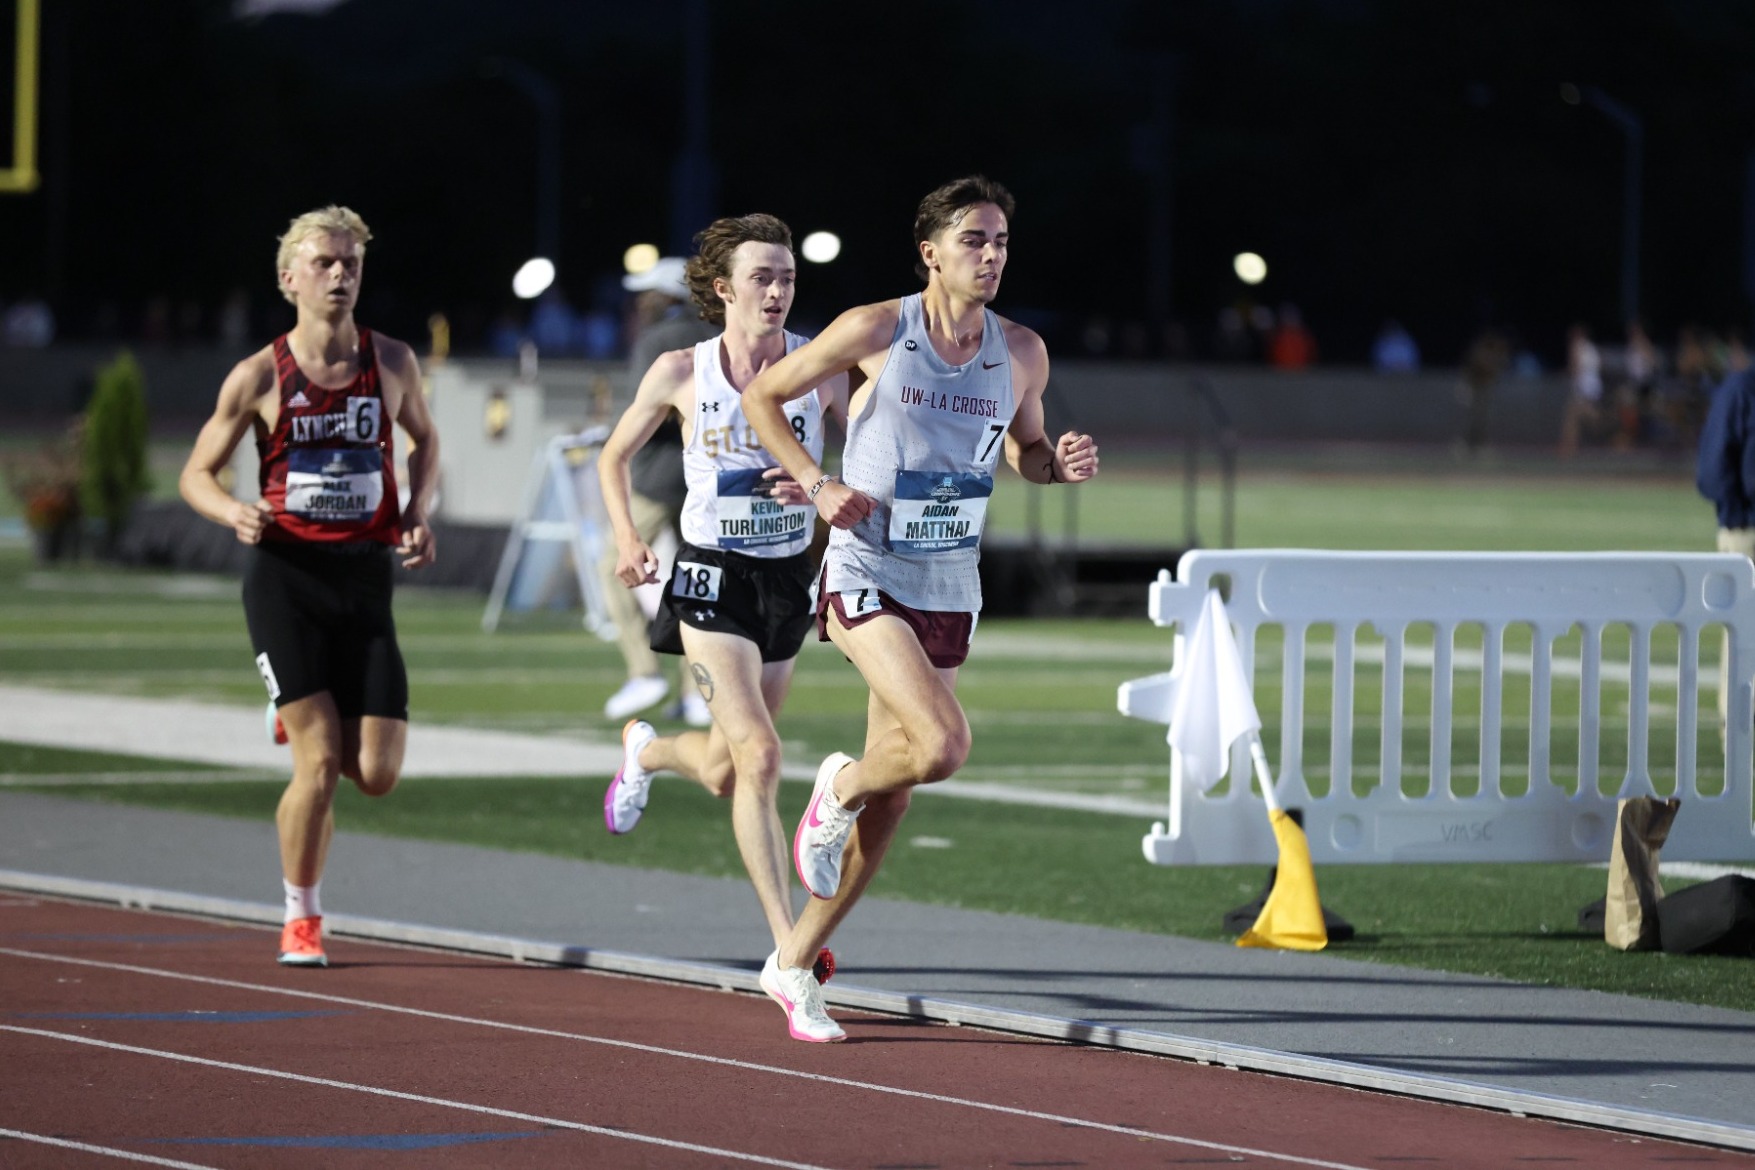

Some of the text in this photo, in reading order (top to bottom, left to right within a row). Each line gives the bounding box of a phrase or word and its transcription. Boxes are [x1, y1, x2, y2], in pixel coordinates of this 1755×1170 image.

[901, 385, 998, 418] UW-LA CROSSE
[356, 402, 373, 440] 6
[702, 425, 740, 459] ST.
[980, 425, 1005, 463] 7
[305, 494, 367, 510] JORDAN
[751, 501, 784, 515] KEVIN
[922, 505, 959, 517] AIDAN
[720, 511, 806, 536] TURLINGTON
[905, 521, 970, 540] MATTHAI
[683, 567, 711, 597] 18
[1441, 821, 1494, 842] VMSC
